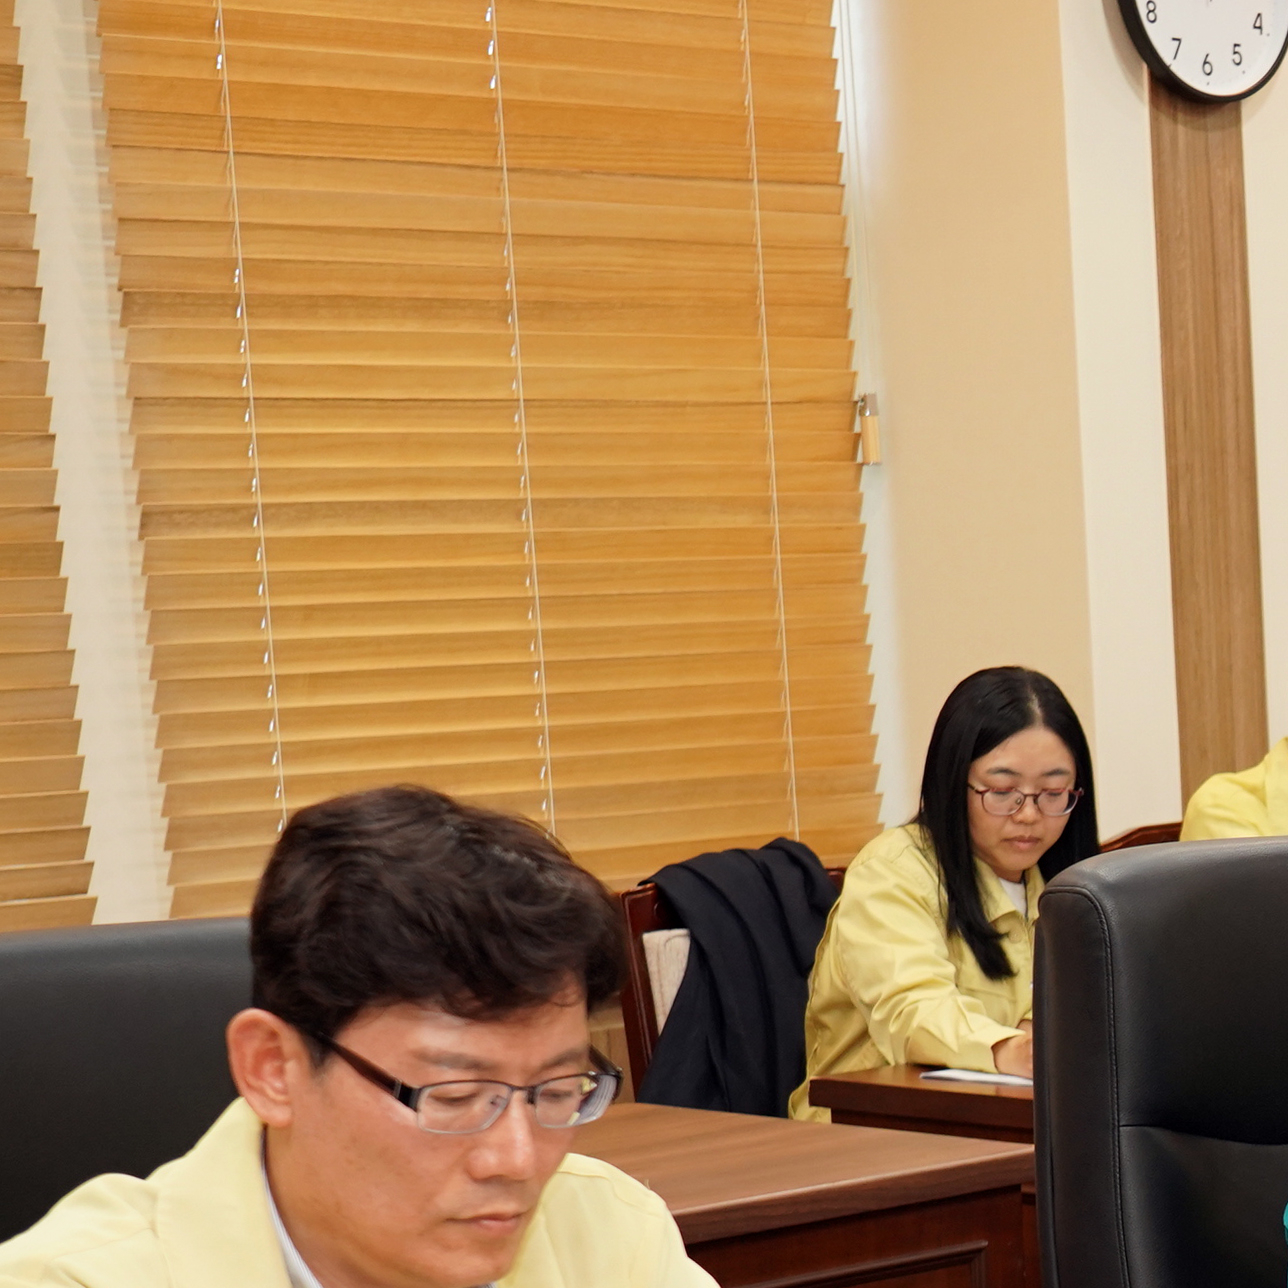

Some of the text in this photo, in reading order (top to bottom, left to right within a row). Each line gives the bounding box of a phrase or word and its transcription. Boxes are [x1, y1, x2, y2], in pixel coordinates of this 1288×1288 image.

[1146, 0, 1157, 23] 8
[1253, 12, 1263, 36] 4
[1171, 37, 1182, 60] 7
[1231, 43, 1243, 66] 5
[1201, 53, 1213, 76] 6
